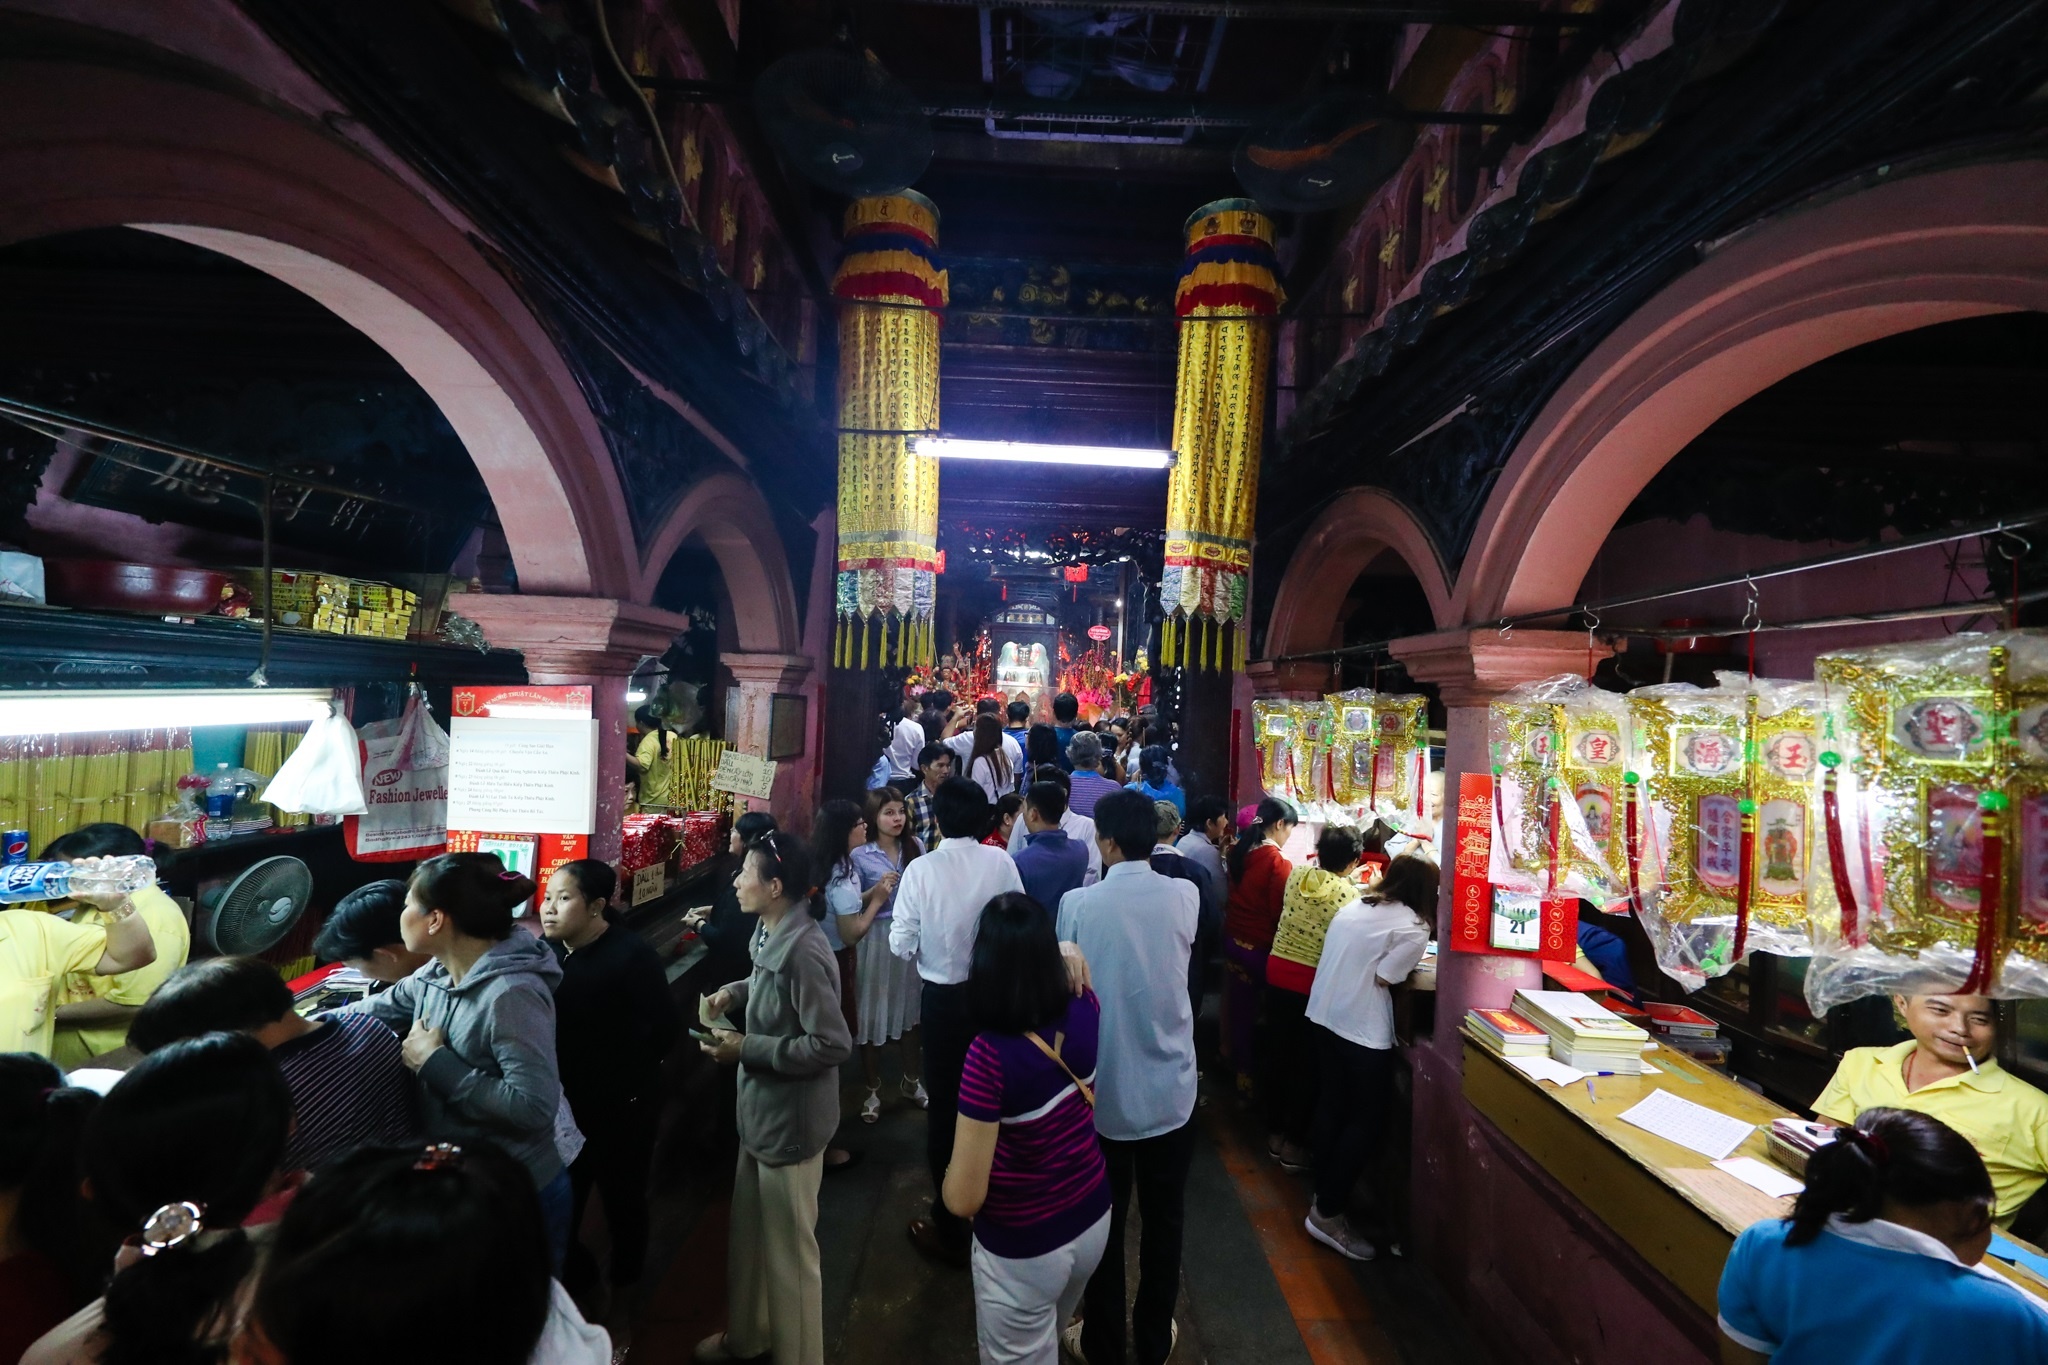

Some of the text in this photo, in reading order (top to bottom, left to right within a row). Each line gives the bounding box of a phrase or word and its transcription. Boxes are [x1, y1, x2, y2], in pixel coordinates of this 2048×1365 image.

[1589, 737, 1608, 760] 皇
[373, 770, 401, 786] NEW
[369, 789, 410, 805] Fashion
[1510, 919, 1525, 934] 21
